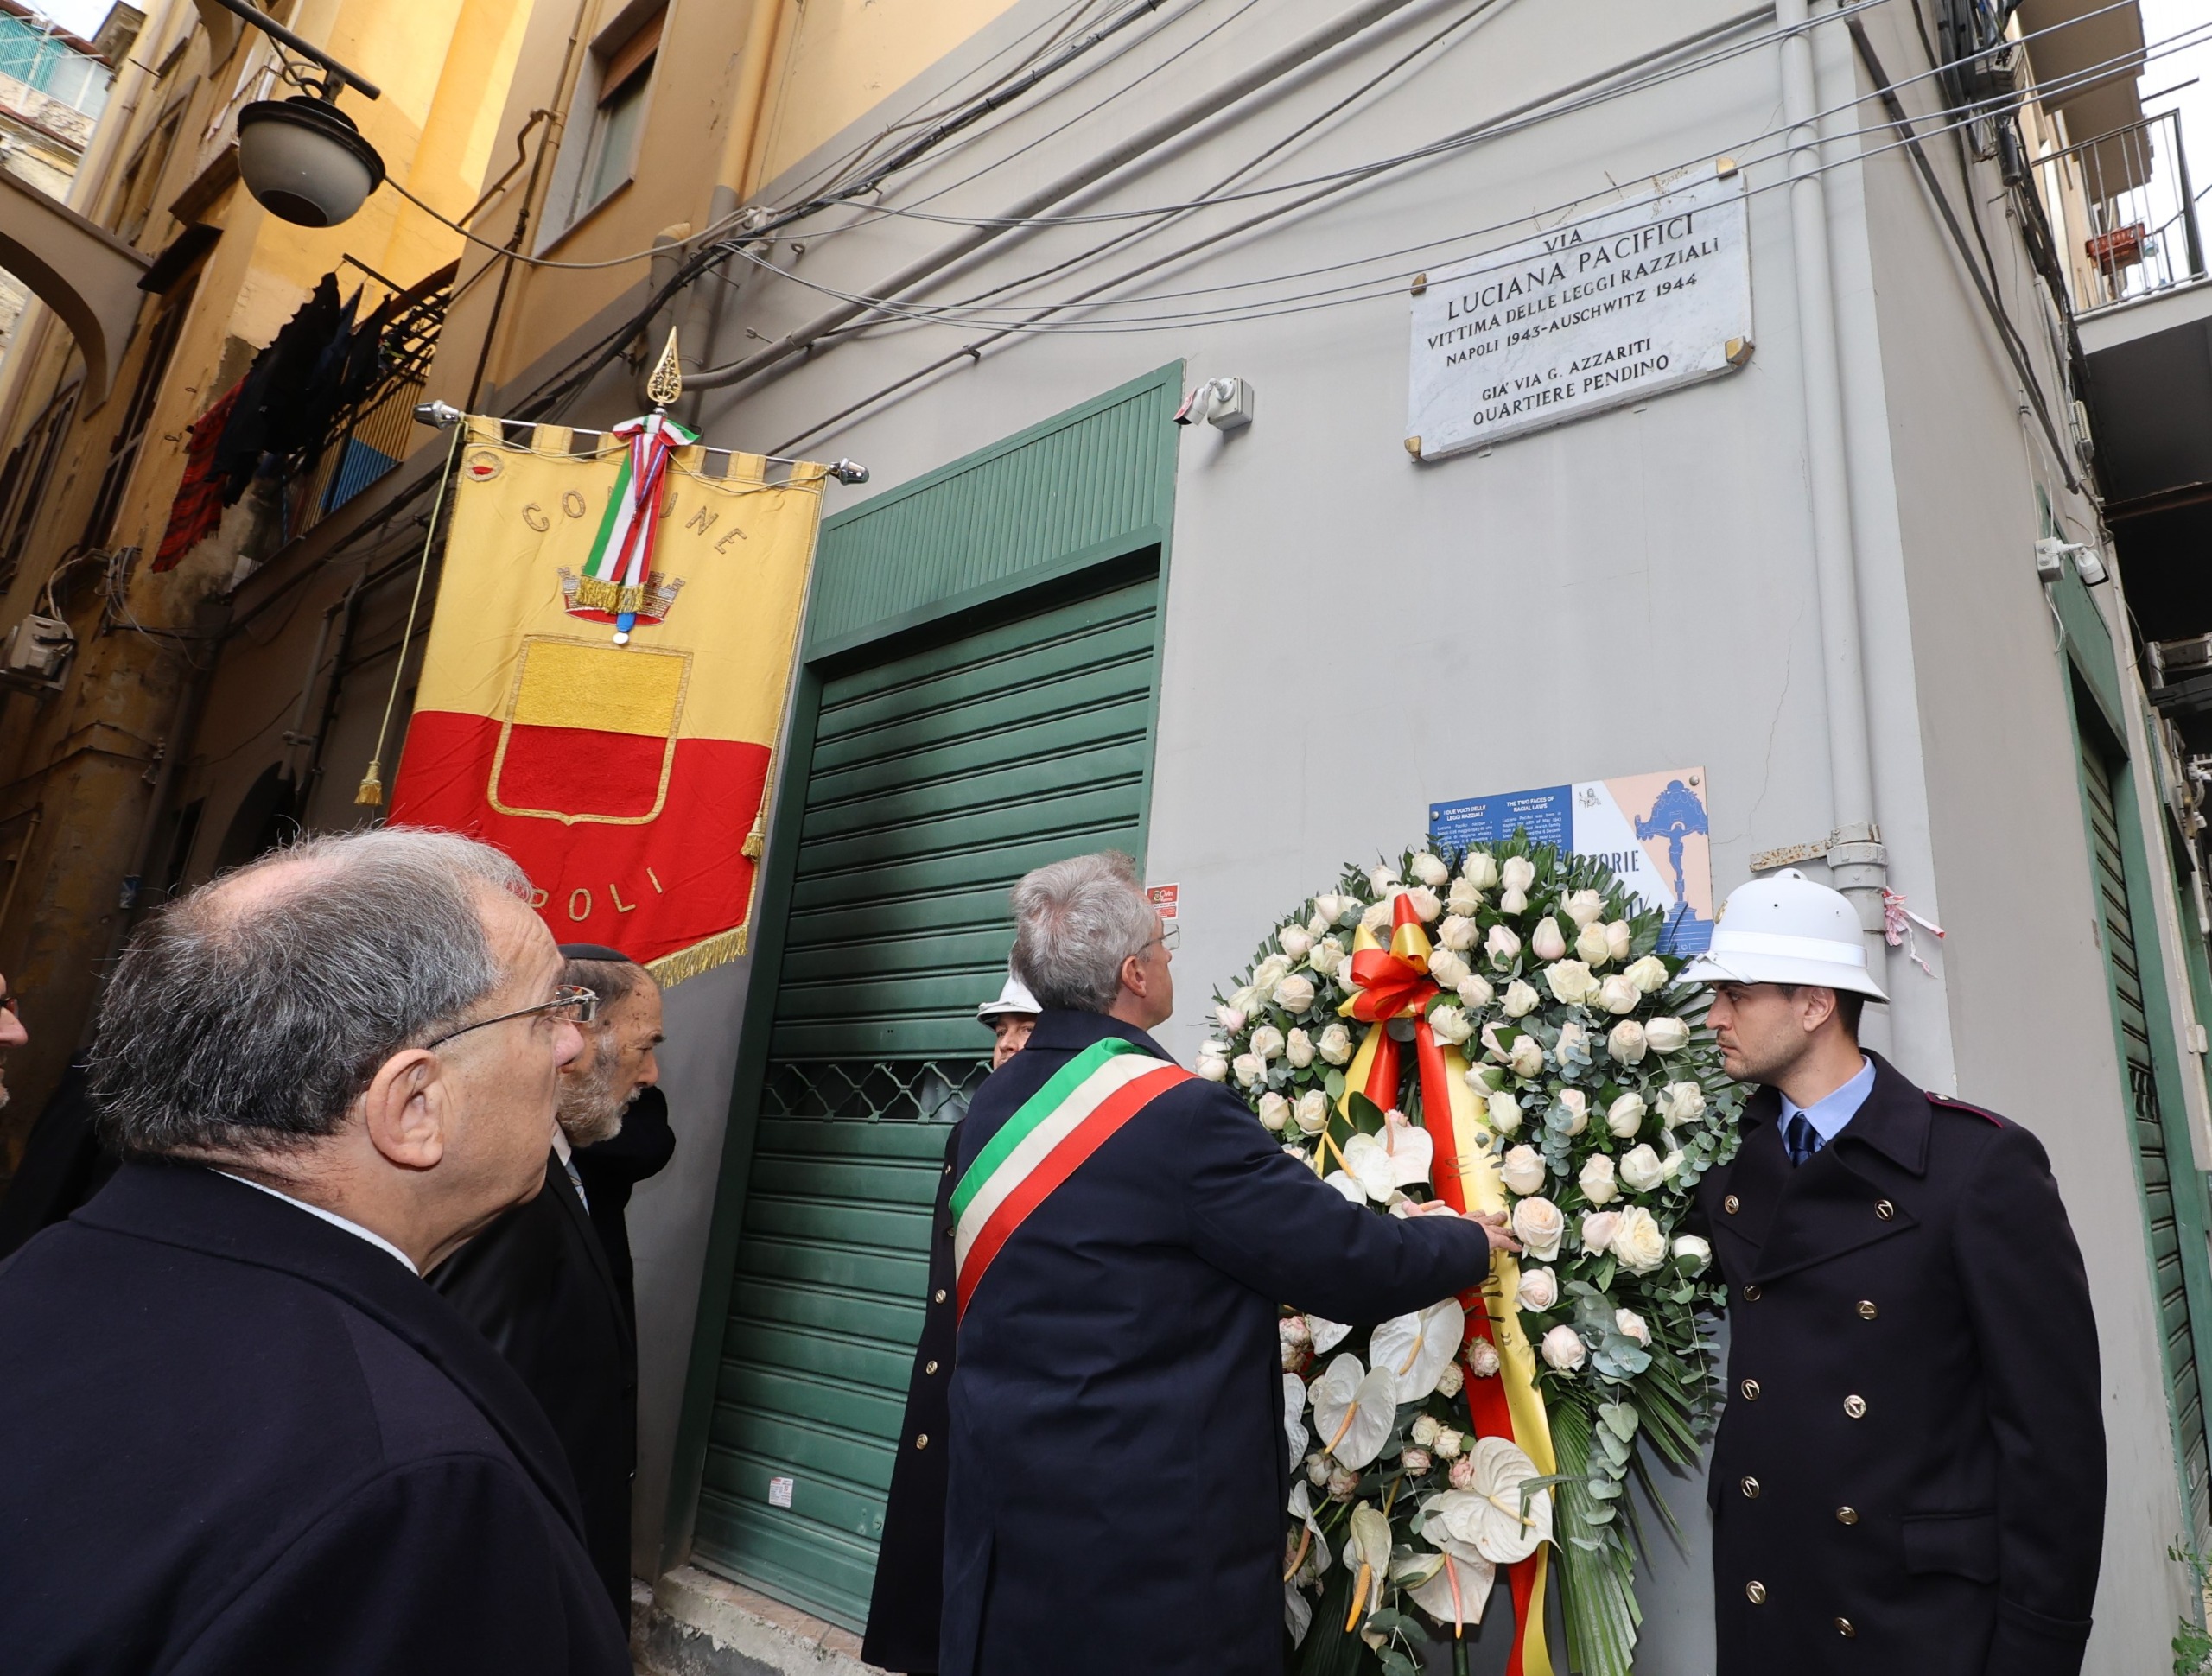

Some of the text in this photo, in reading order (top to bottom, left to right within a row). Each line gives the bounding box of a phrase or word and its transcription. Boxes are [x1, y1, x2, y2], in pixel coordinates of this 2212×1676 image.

[1447, 213, 1694, 321] LUCIANA PACIFICI
[1544, 228, 1583, 255] VIA
[1427, 237, 1720, 350] VITTIMA DELLE LEGGI RAZZIALI
[1446, 340, 1499, 367] NAPOLI
[1656, 273, 1698, 297] 1944
[1473, 354, 1669, 426] QUARTIERE PENDINO
[1515, 373, 1542, 391] VIA
[1548, 367, 1563, 381] G.
[1569, 338, 1651, 374] AZZARITI
[522, 486, 747, 555] COUNE
[529, 867, 663, 922] POLI
[1575, 850, 1640, 876] TORIE
